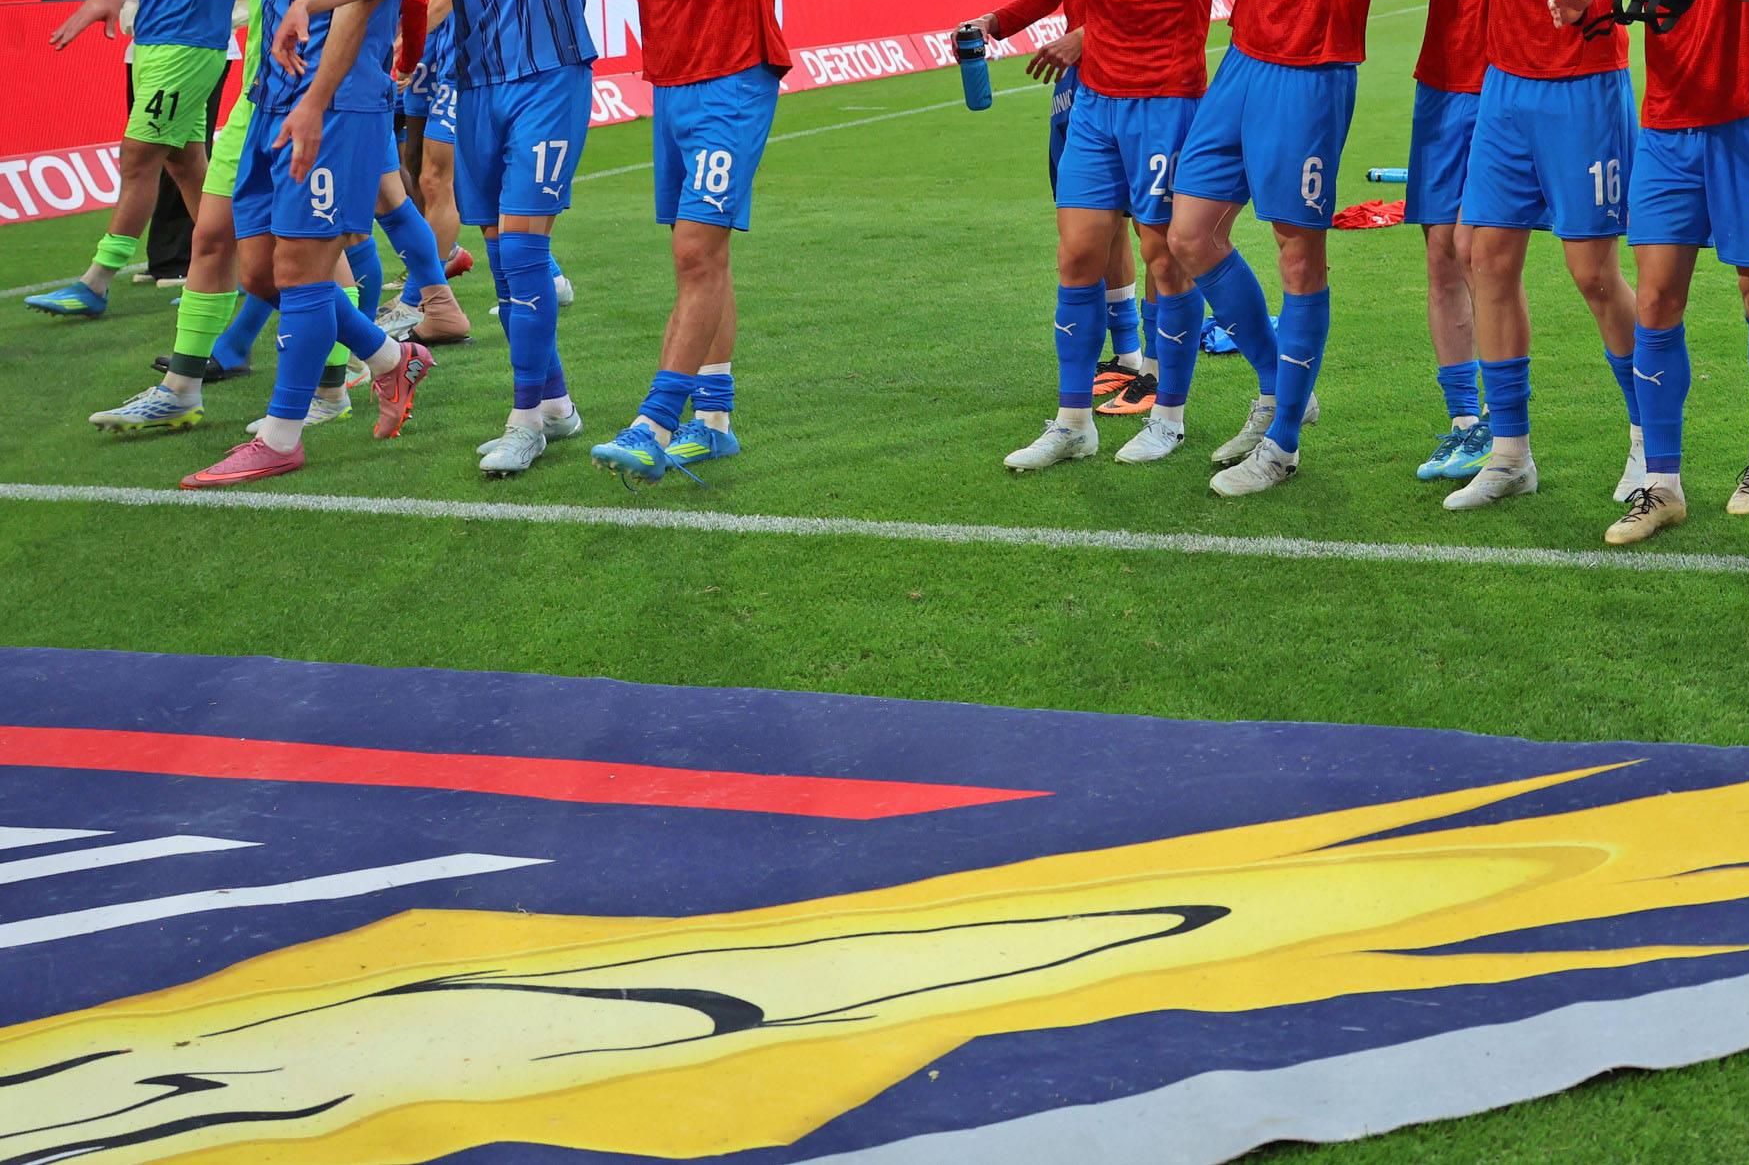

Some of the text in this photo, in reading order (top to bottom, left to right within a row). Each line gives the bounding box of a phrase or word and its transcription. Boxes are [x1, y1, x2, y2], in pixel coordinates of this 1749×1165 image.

[1026, 15, 1068, 50] DERT
[800, 38, 914, 85] DERTOUR
[145, 89, 180, 121] 41
[0, 146, 121, 220] TOU
[531, 140, 569, 184] 17
[693, 148, 732, 193] 18
[1301, 156, 1323, 200] 6
[1588, 157, 1621, 207] 16
[310, 167, 335, 211] 9
